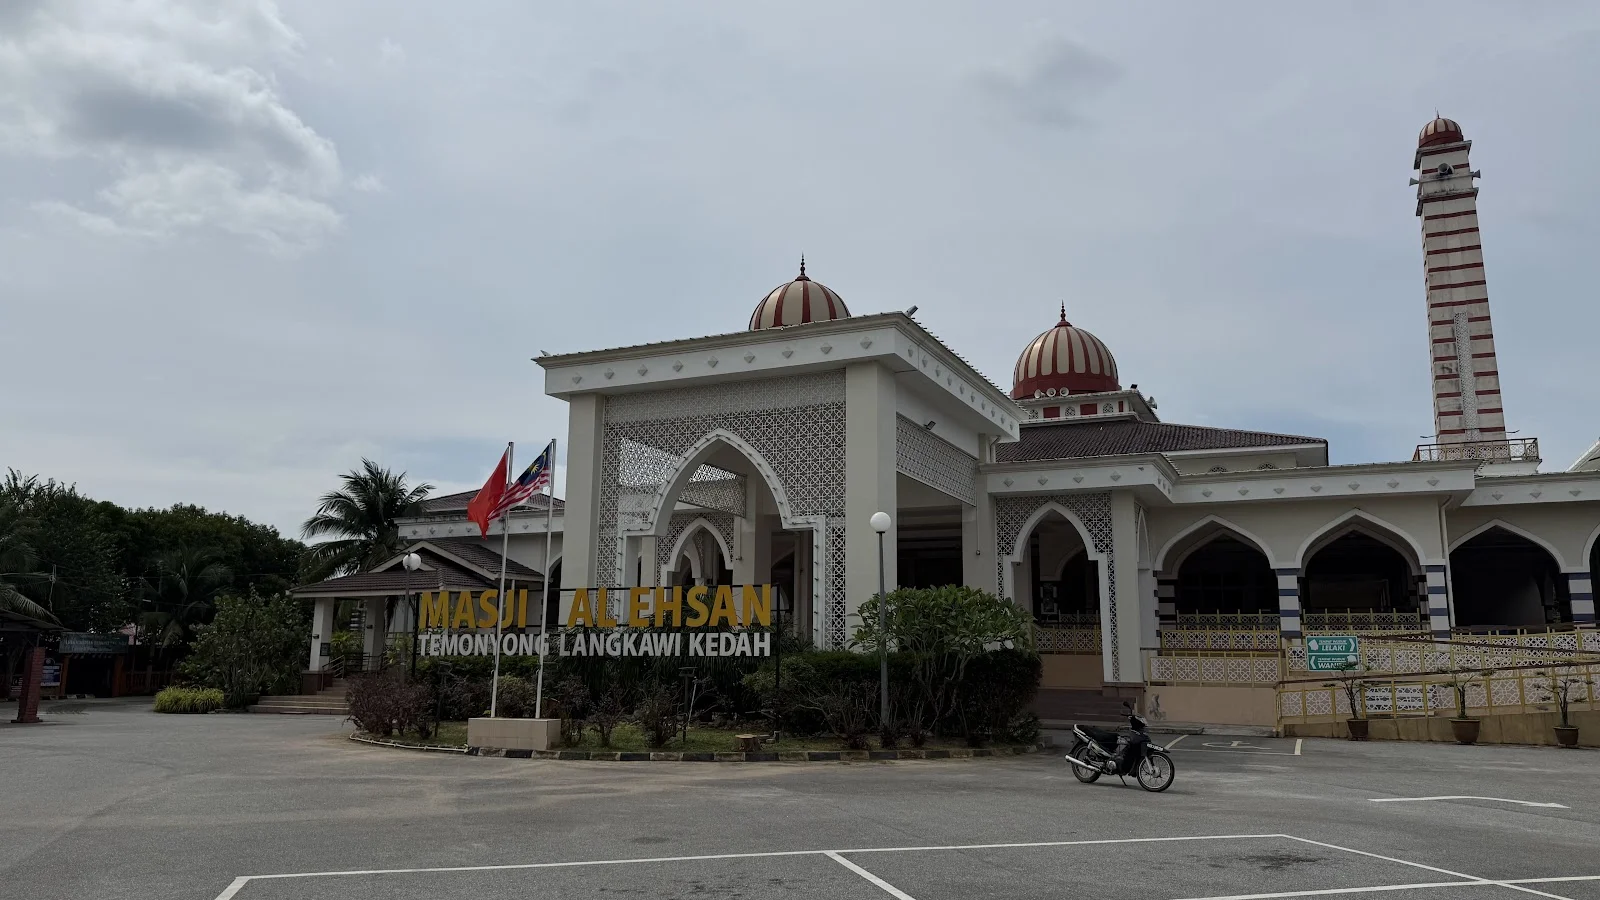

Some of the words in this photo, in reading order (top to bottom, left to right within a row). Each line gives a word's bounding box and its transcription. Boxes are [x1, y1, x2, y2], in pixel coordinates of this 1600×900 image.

[418, 589, 528, 629] MASJI
[567, 588, 617, 628] AL
[630, 585, 772, 628] EHSAN
[418, 633, 549, 656] TEMONYONG
[560, 633, 680, 656] LANGKAWI
[690, 633, 771, 656] KEDAH
